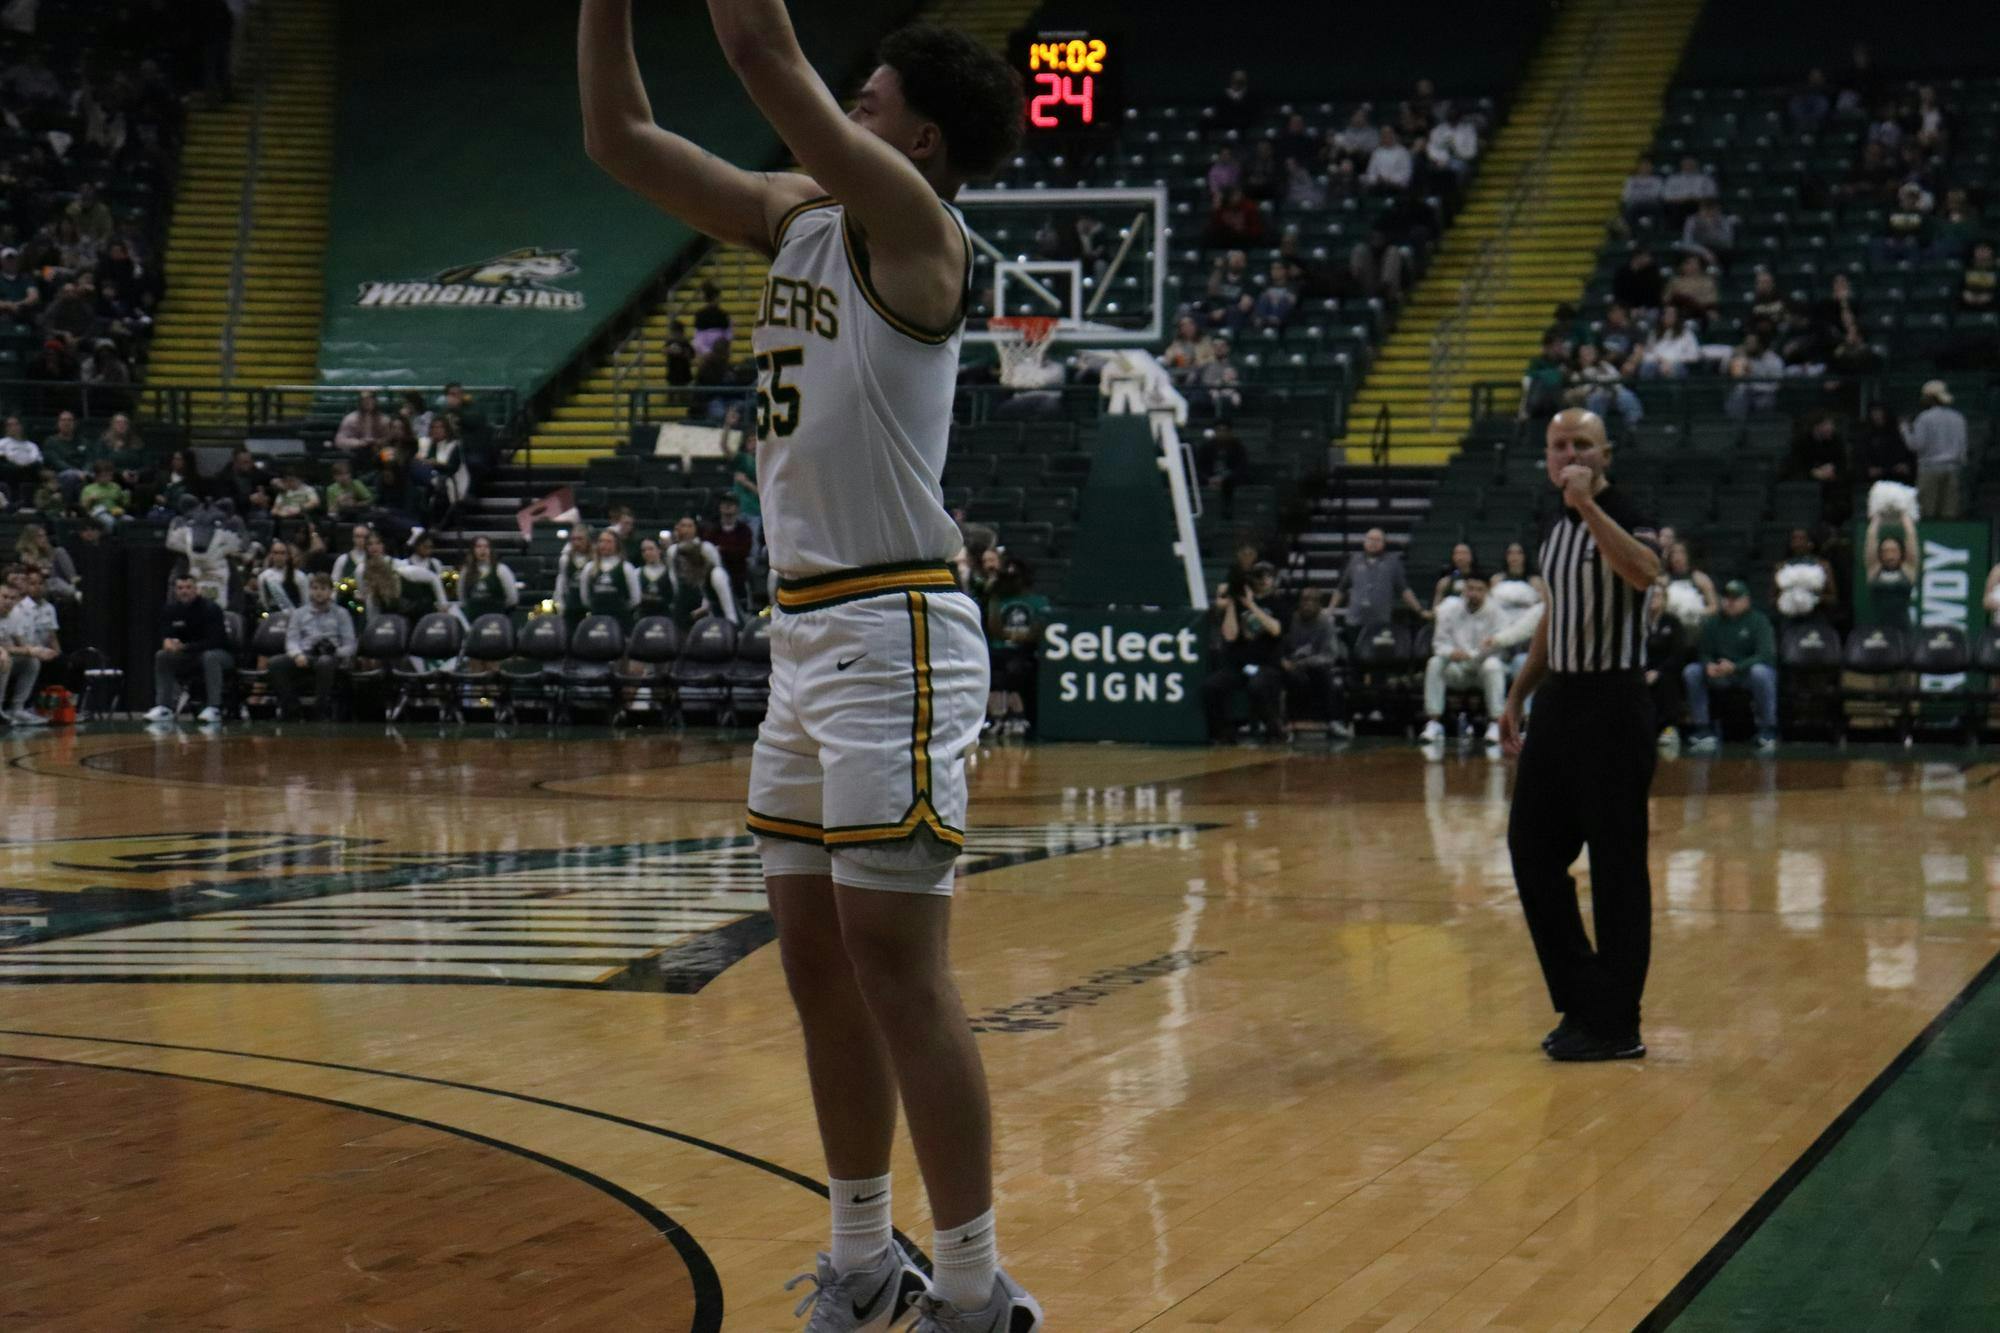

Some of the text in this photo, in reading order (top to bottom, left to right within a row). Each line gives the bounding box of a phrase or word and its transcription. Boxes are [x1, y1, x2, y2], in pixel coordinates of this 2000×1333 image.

[1030, 39, 1107, 72] 14:02
[1031, 73, 1093, 127] 24
[358, 282, 581, 309] WRIGHT STATE
[1044, 622, 1199, 664] Select
[1060, 671, 1185, 702] SIGNS
